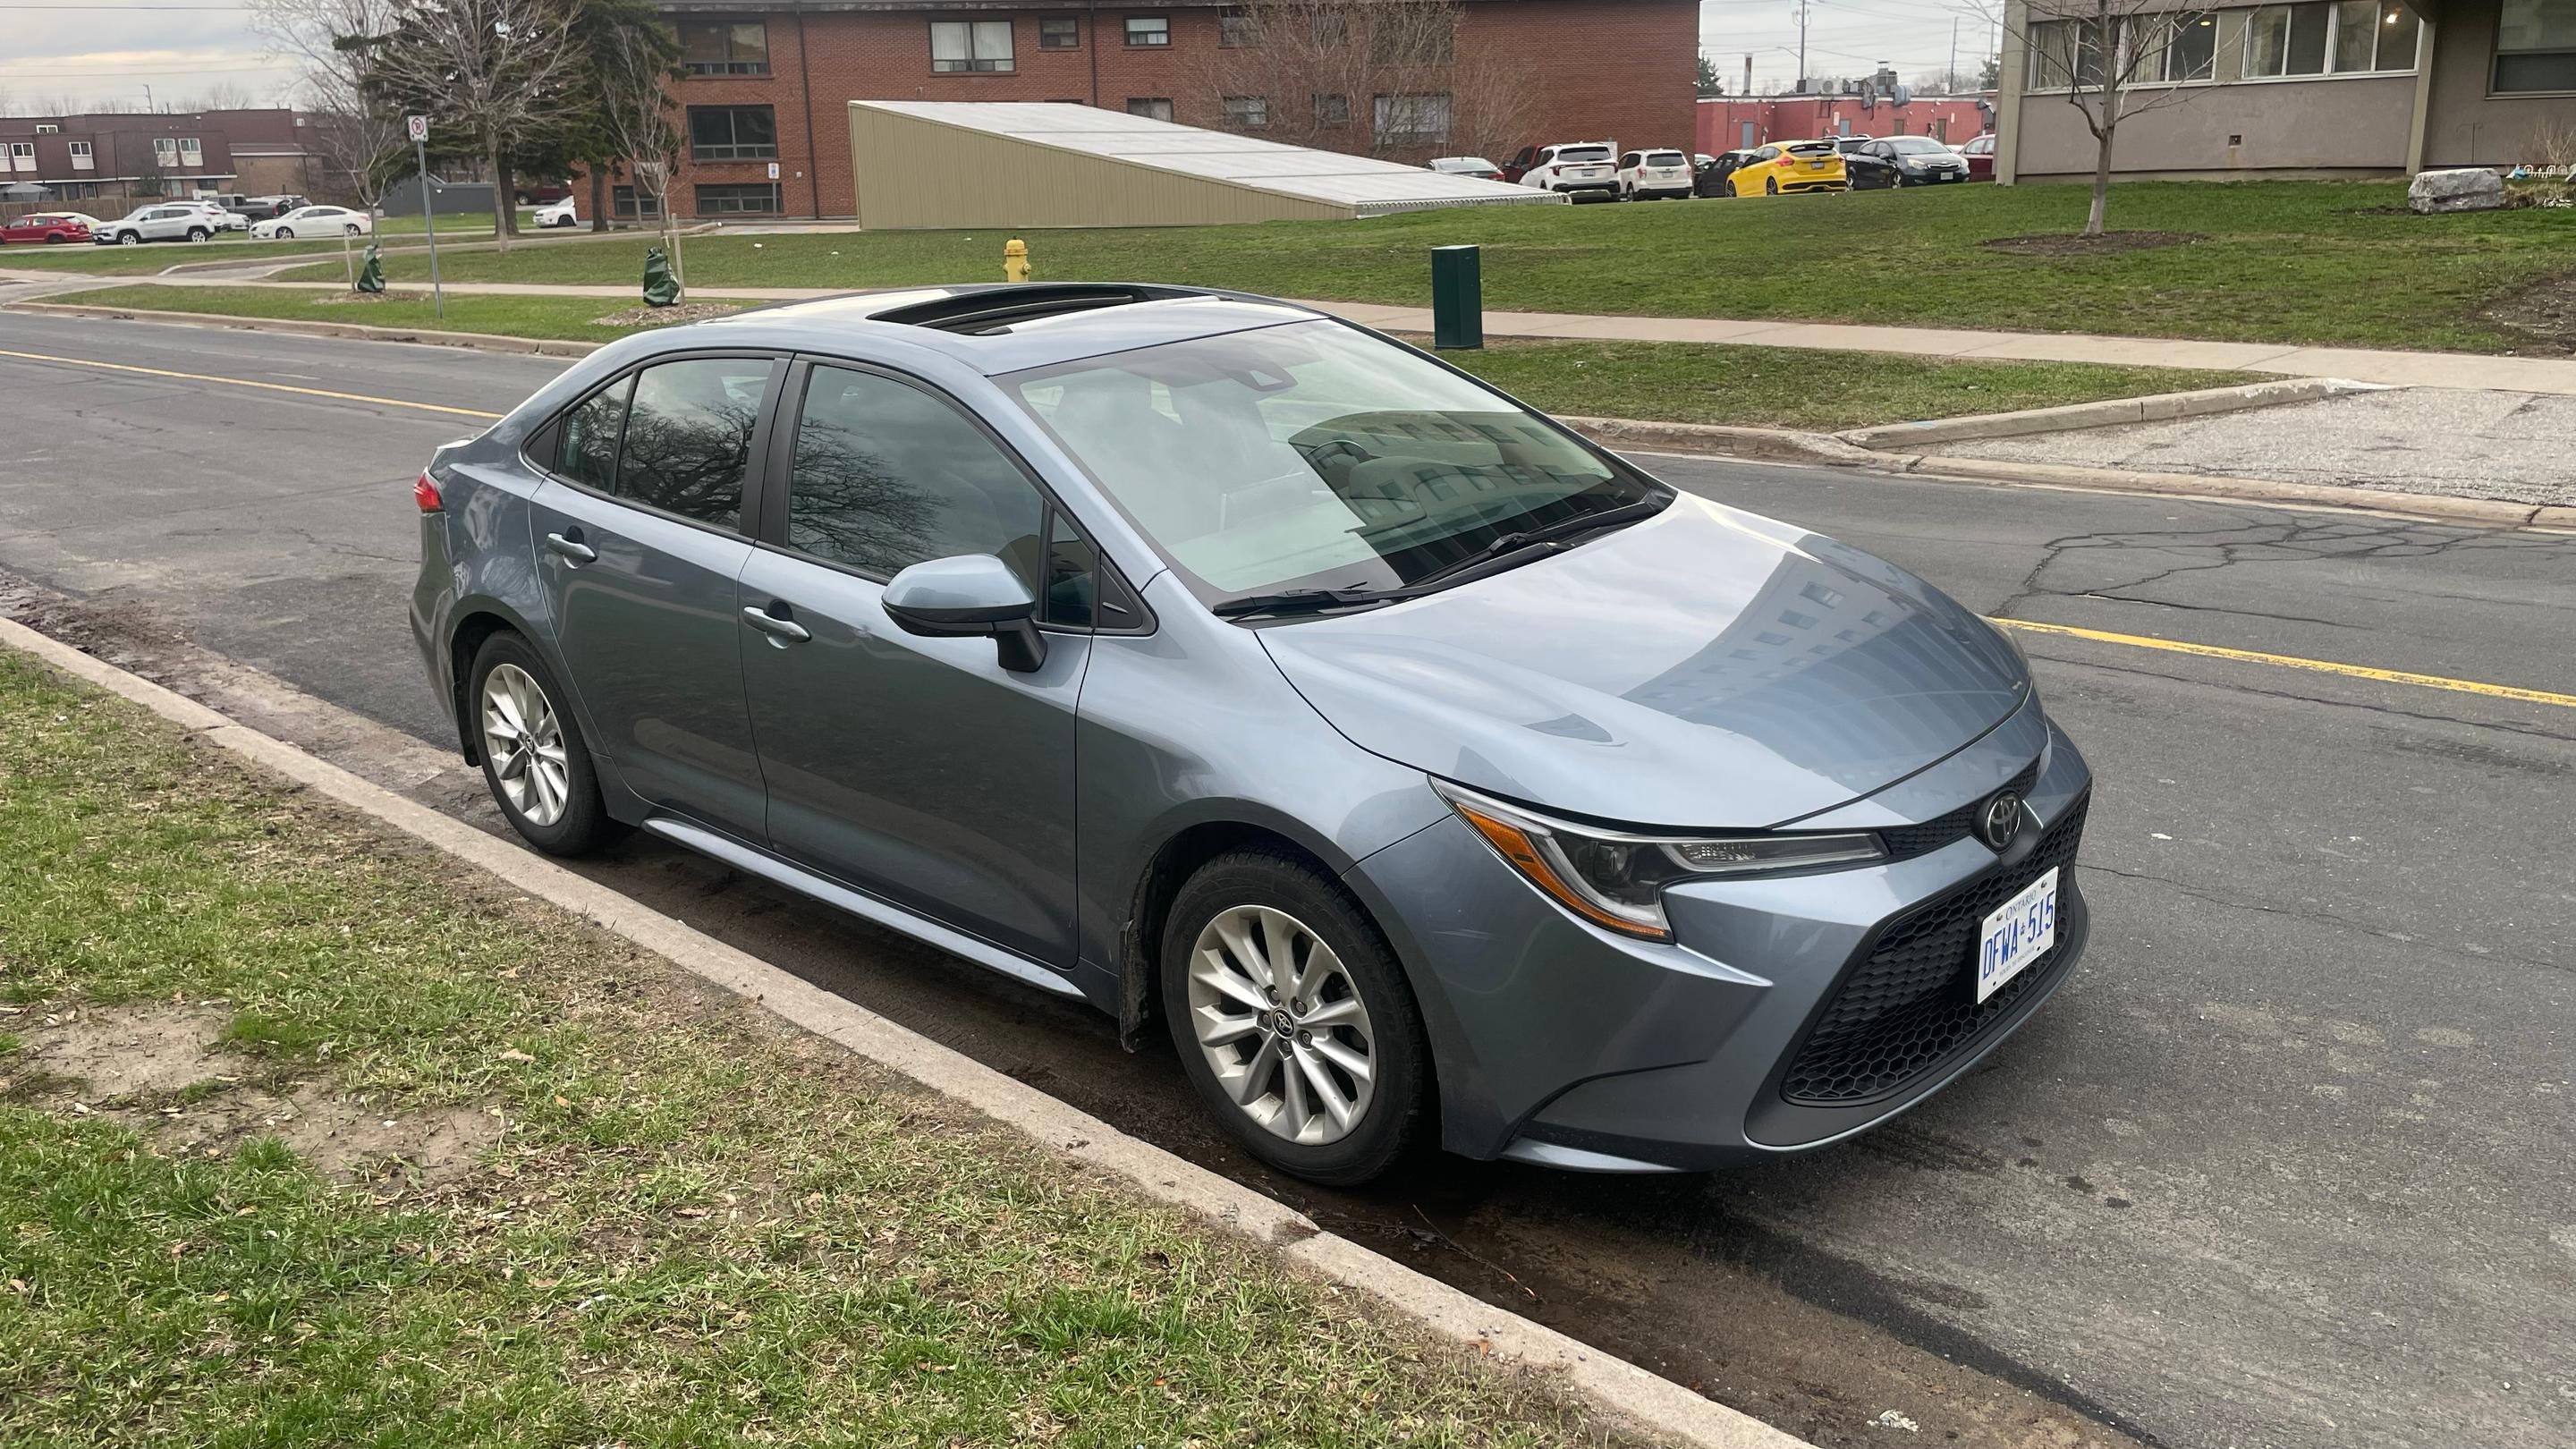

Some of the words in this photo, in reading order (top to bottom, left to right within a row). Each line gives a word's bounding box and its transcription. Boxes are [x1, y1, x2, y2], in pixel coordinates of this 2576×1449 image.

[2005, 889, 2036, 920] ONTARIO
[1982, 918, 2018, 980] DFWA
[2028, 890, 2055, 944] 515
